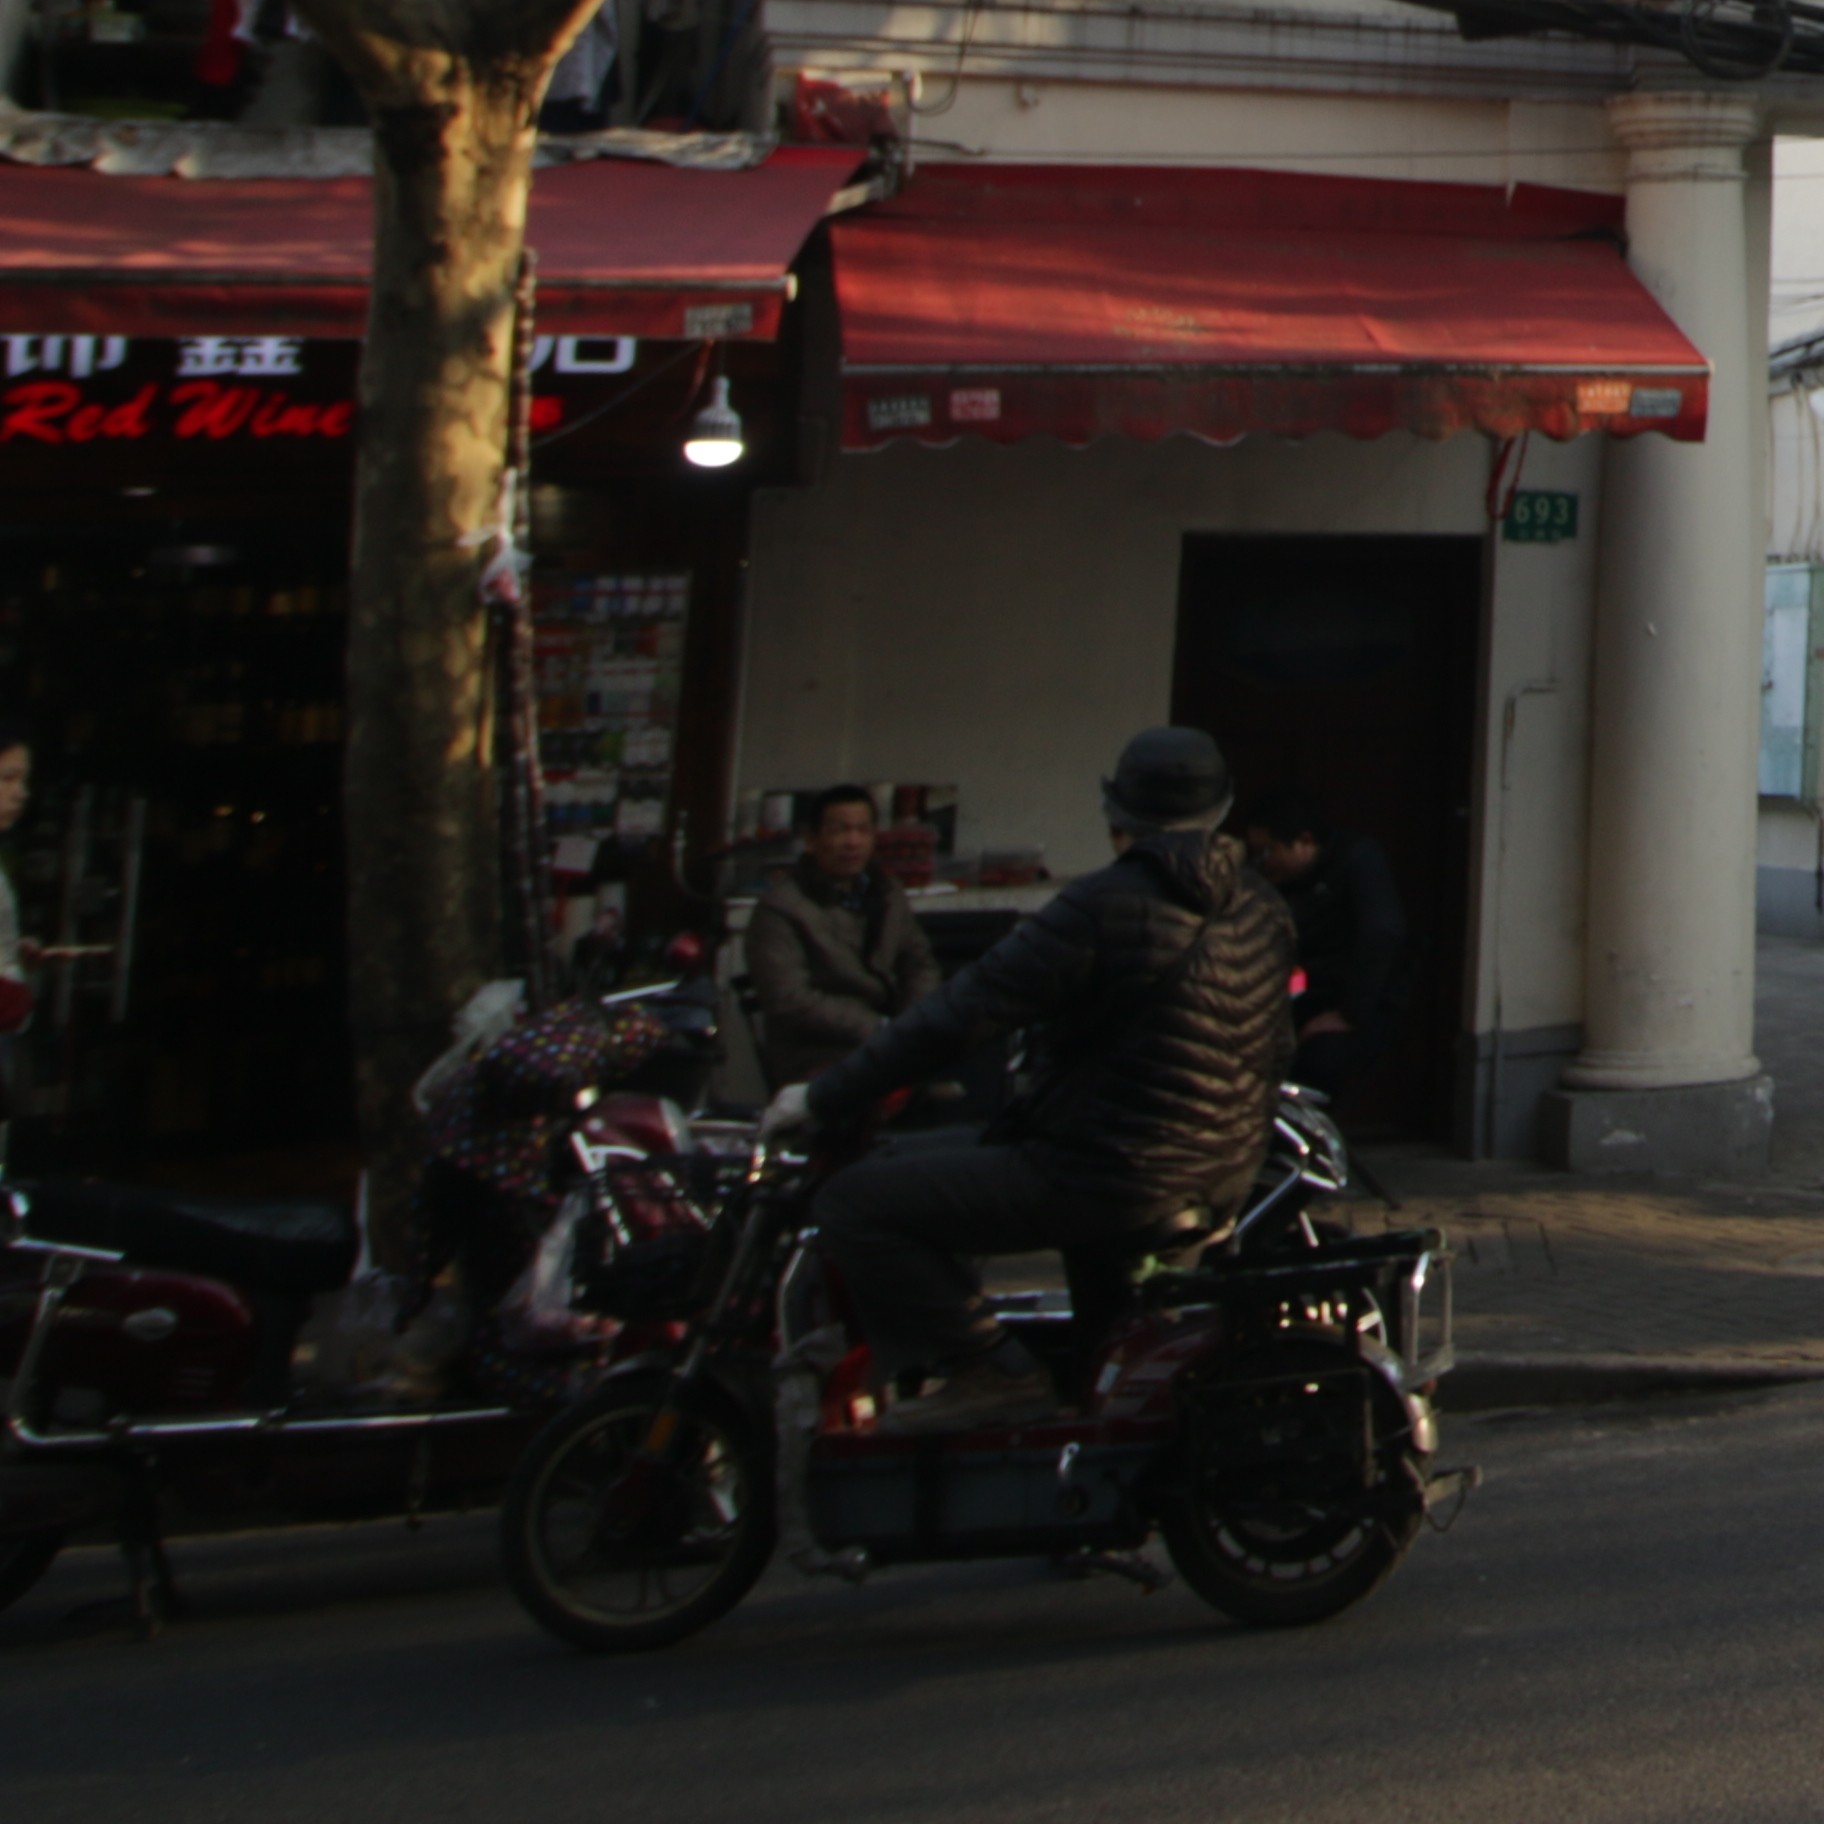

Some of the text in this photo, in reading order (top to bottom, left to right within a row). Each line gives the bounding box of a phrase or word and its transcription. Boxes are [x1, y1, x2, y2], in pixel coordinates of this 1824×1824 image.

[0, 380, 357, 444] Red Wine
[1513, 495, 1570, 526] 693
